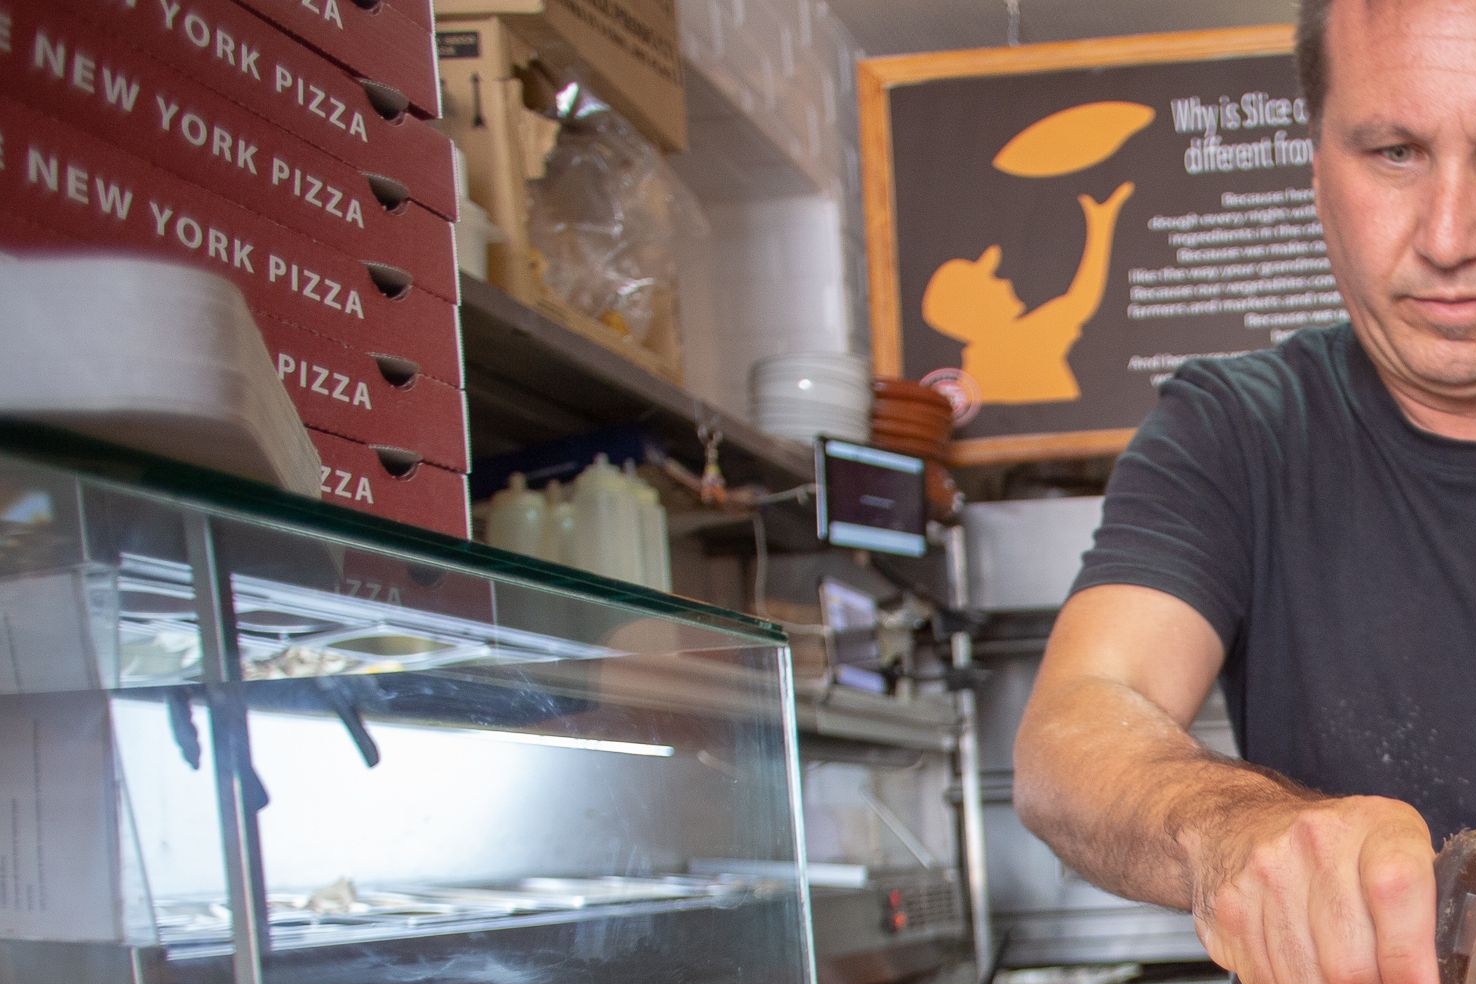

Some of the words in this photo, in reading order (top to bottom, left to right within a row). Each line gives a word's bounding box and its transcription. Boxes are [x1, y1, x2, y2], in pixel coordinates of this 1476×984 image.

[160, 0, 260, 80] YORK
[275, 64, 369, 143] PIZZA
[34, 32, 140, 113] NEW
[156, 95, 258, 175] YORK
[272, 157, 365, 229] PIZZA
[1171, 96, 1219, 138] Why
[1219, 95, 1241, 130] is
[1240, 91, 1293, 128] Slice
[1184, 132, 1274, 175] different
[28, 147, 133, 220] NEW
[149, 200, 254, 273] YORK
[268, 254, 365, 319] PIZZA
[277, 353, 372, 410] PIZZA
[320, 465, 374, 505] ZZA
